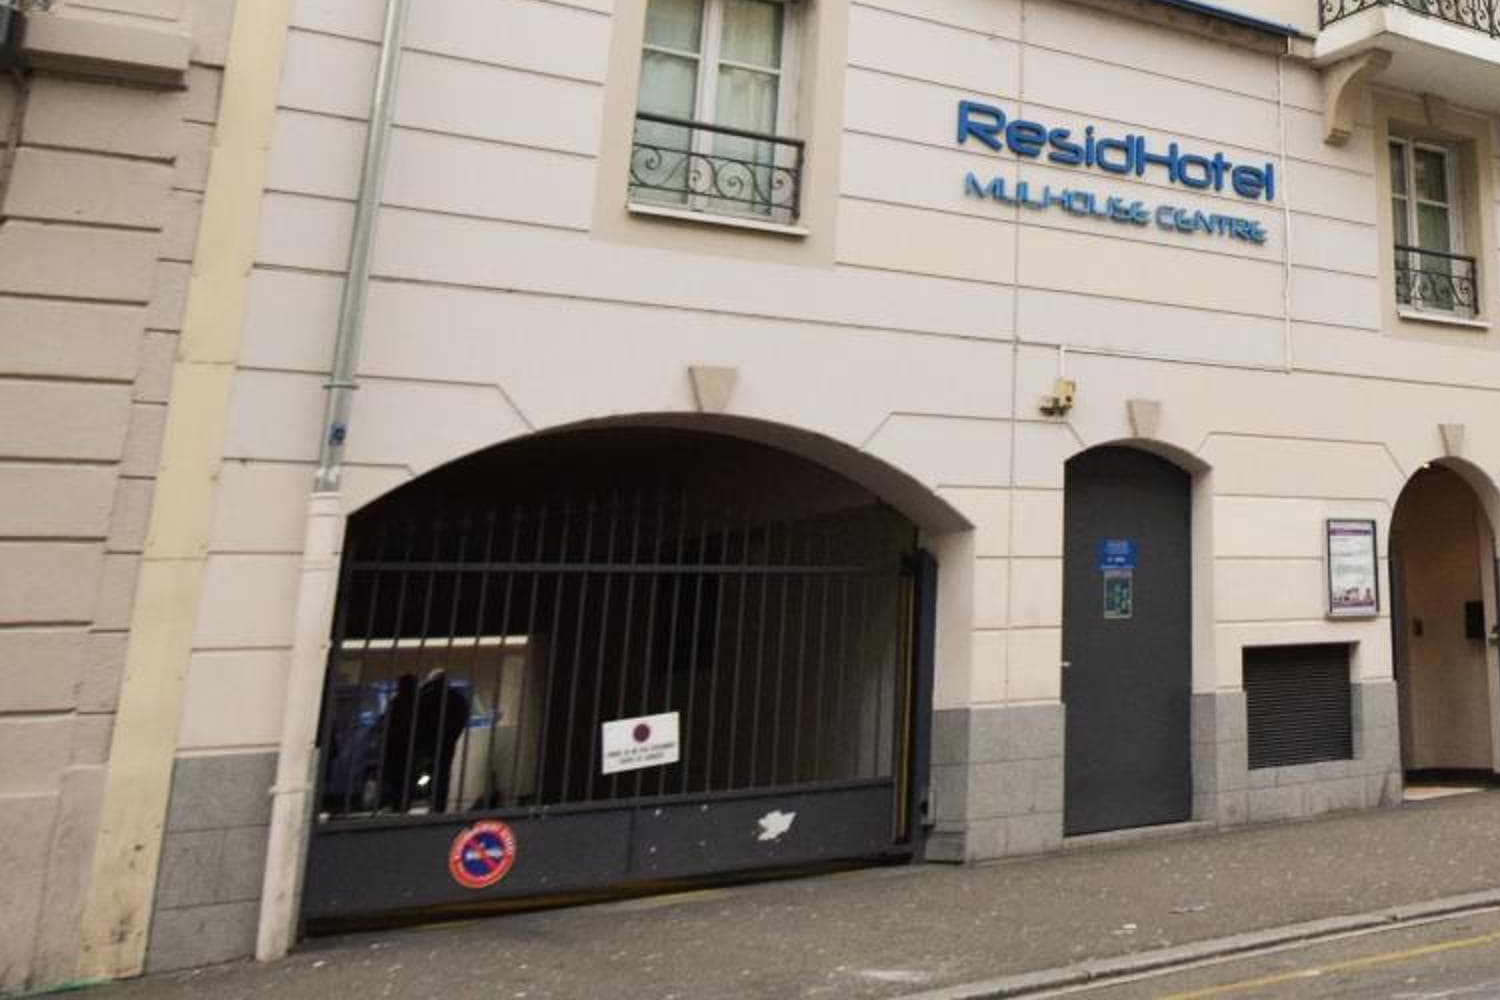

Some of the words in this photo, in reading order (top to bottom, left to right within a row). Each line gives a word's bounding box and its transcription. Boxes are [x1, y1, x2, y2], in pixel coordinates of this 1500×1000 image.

[956, 99, 1276, 201] ResidHotel
[964, 171, 1151, 226] MULHOUSE
[1155, 204, 1268, 245] CENTRE
